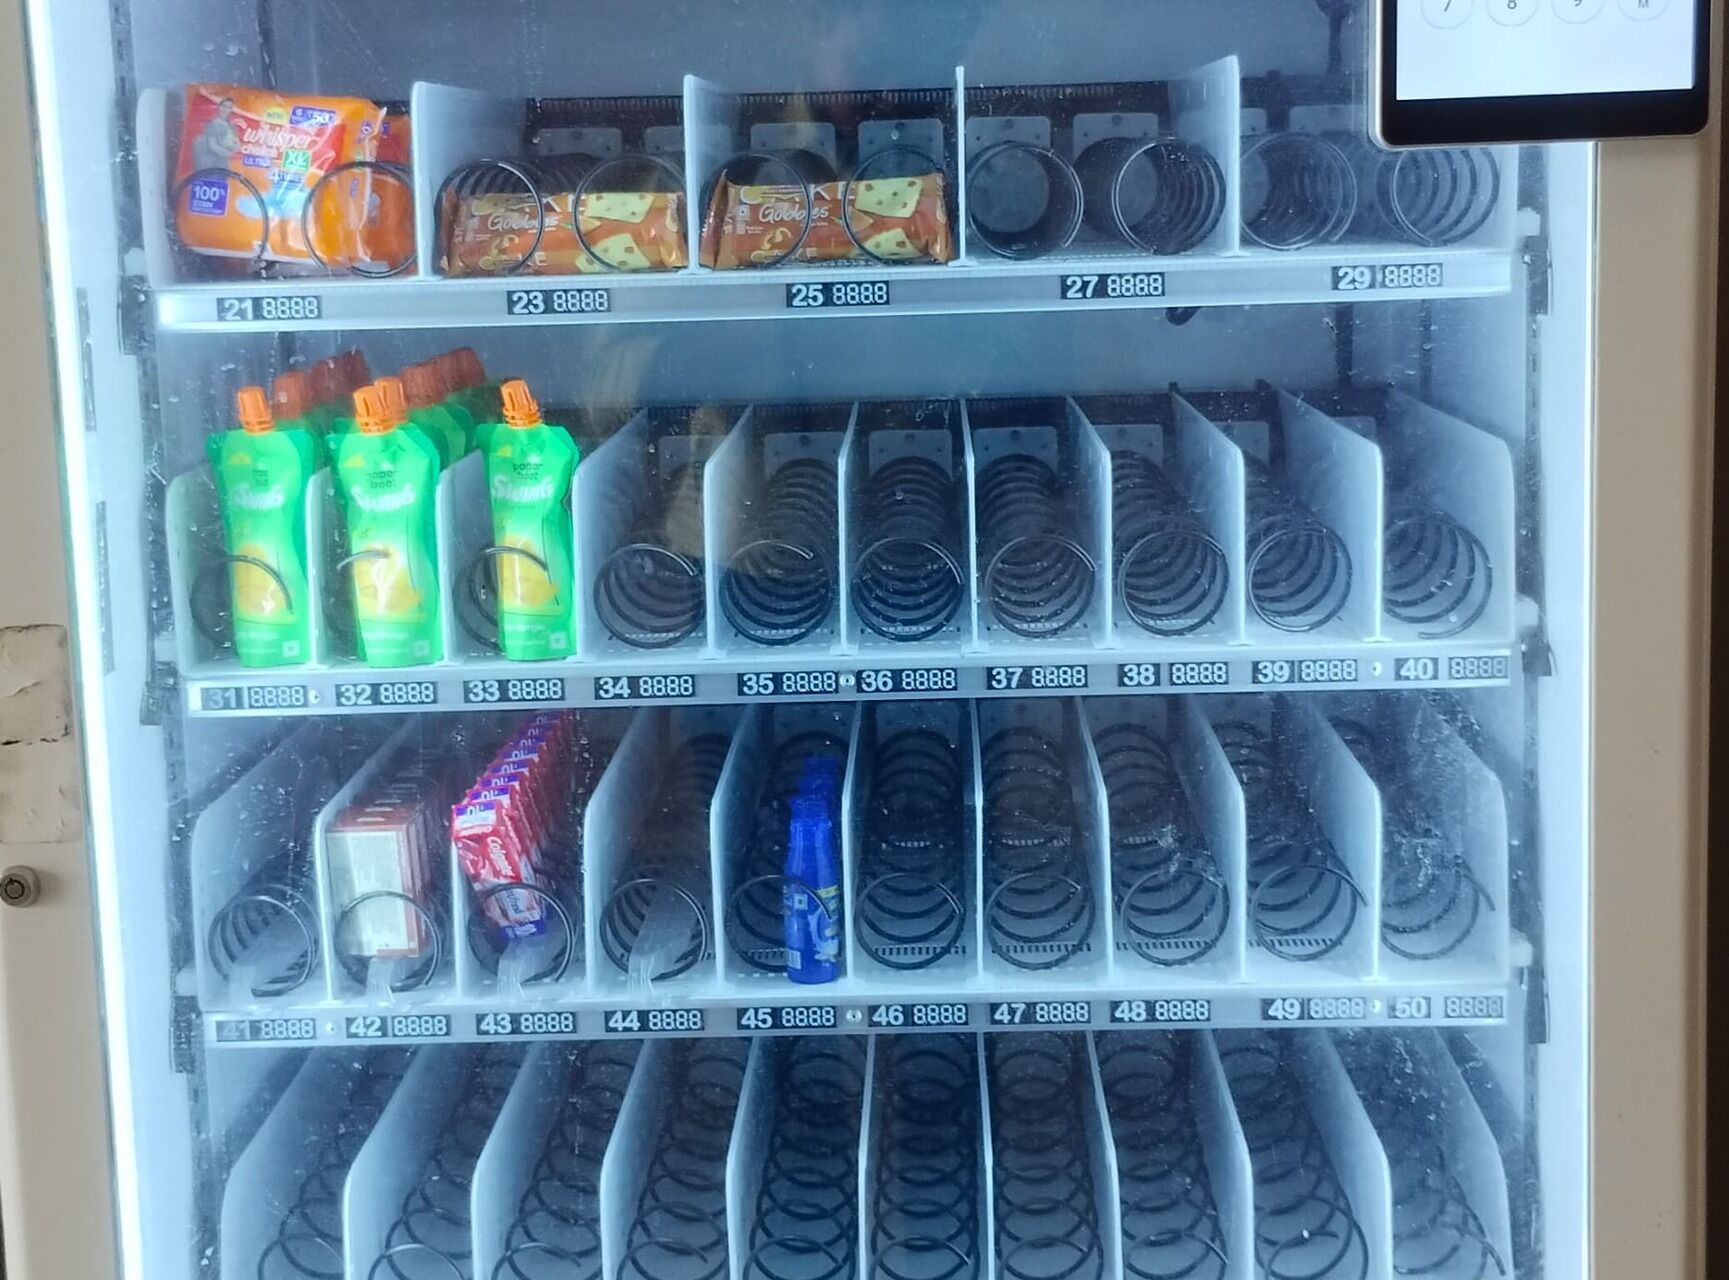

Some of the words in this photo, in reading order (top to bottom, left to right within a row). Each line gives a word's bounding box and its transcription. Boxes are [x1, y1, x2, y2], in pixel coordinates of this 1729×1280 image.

[243, 122, 320, 152] whisper
[287, 150, 306, 165] XL
[193, 185, 226, 202] 100%
[1066, 276, 1098, 298] 27
[1338, 267, 1371, 290] 29
[513, 292, 545, 314] 23
[791, 285, 823, 307] 25
[223, 298, 253, 320] 21
[991, 667, 1023, 689] 37
[1123, 664, 1155, 686] 38
[1257, 661, 1289, 683] 39
[1400, 658, 1435, 680] 40
[468, 680, 500, 702] 33
[598, 677, 631, 698] 34
[742, 673, 774, 695] 35
[861, 670, 893, 692] 36
[209, 688, 237, 709] 31
[339, 684, 373, 706] 32
[741, 1008, 772, 1029] 45
[872, 1004, 904, 1026] 46
[993, 1002, 1027, 1024] 47
[1114, 1000, 1147, 1022] 48
[1268, 998, 1300, 1020] 49
[1394, 997, 1428, 1019] 50
[349, 1016, 383, 1037] 42
[480, 1013, 512, 1035] 43
[608, 1010, 641, 1032] 44
